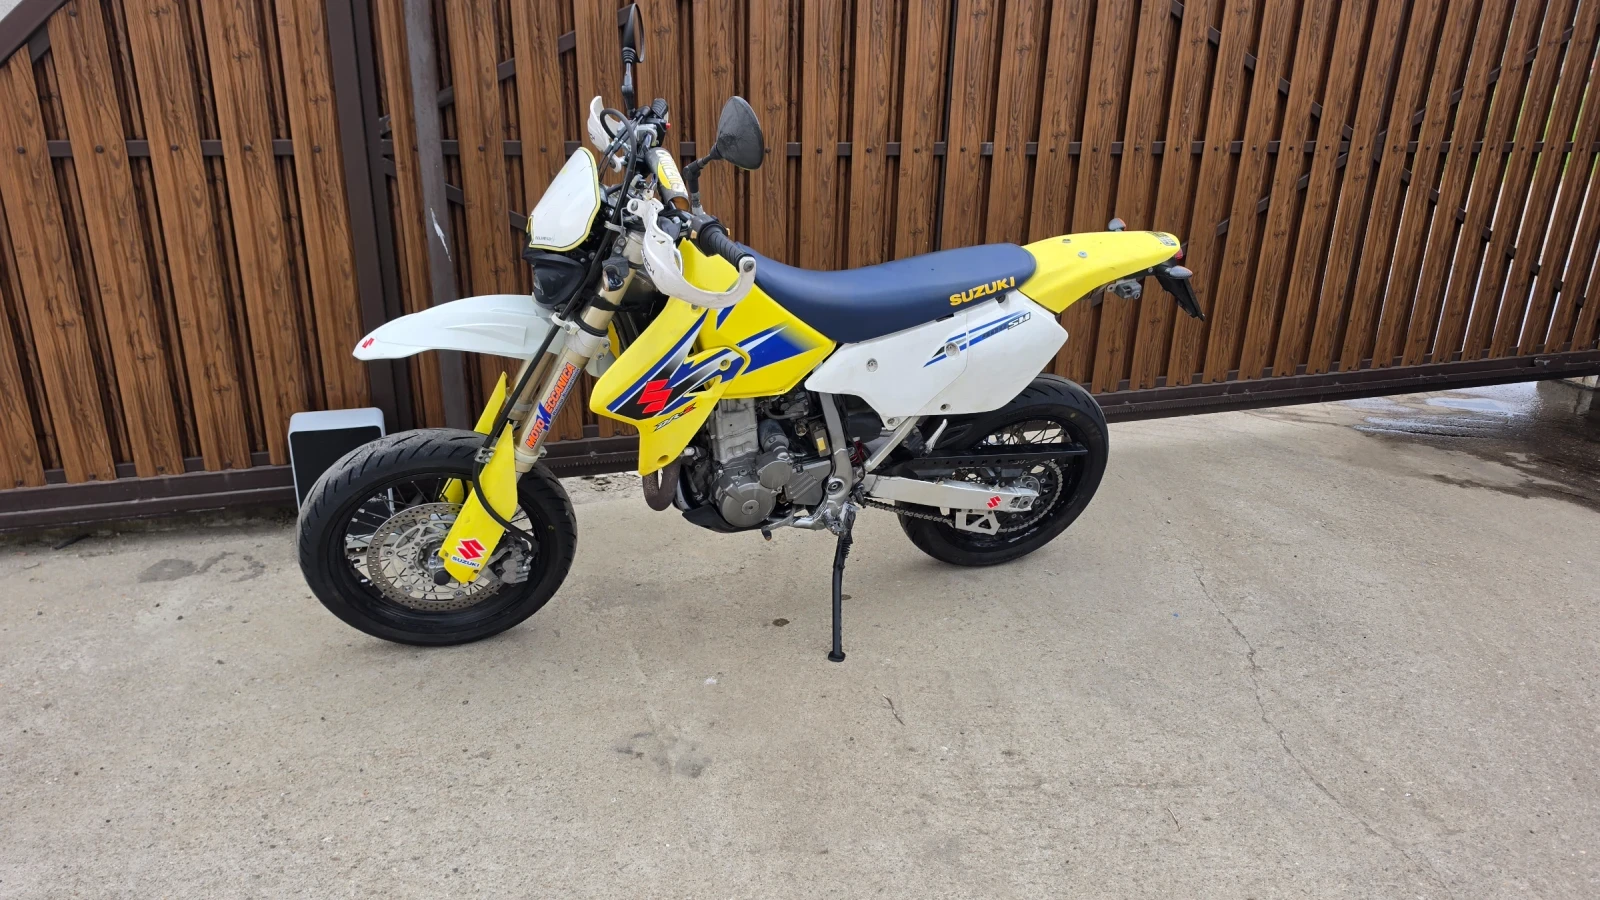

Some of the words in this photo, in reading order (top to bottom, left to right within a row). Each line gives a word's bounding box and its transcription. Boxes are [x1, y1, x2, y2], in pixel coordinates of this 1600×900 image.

[949, 276, 1015, 306] SUZUKI
[525, 362, 577, 450] MOTOMECCANICA
[452, 556, 480, 568] SUZUKI
